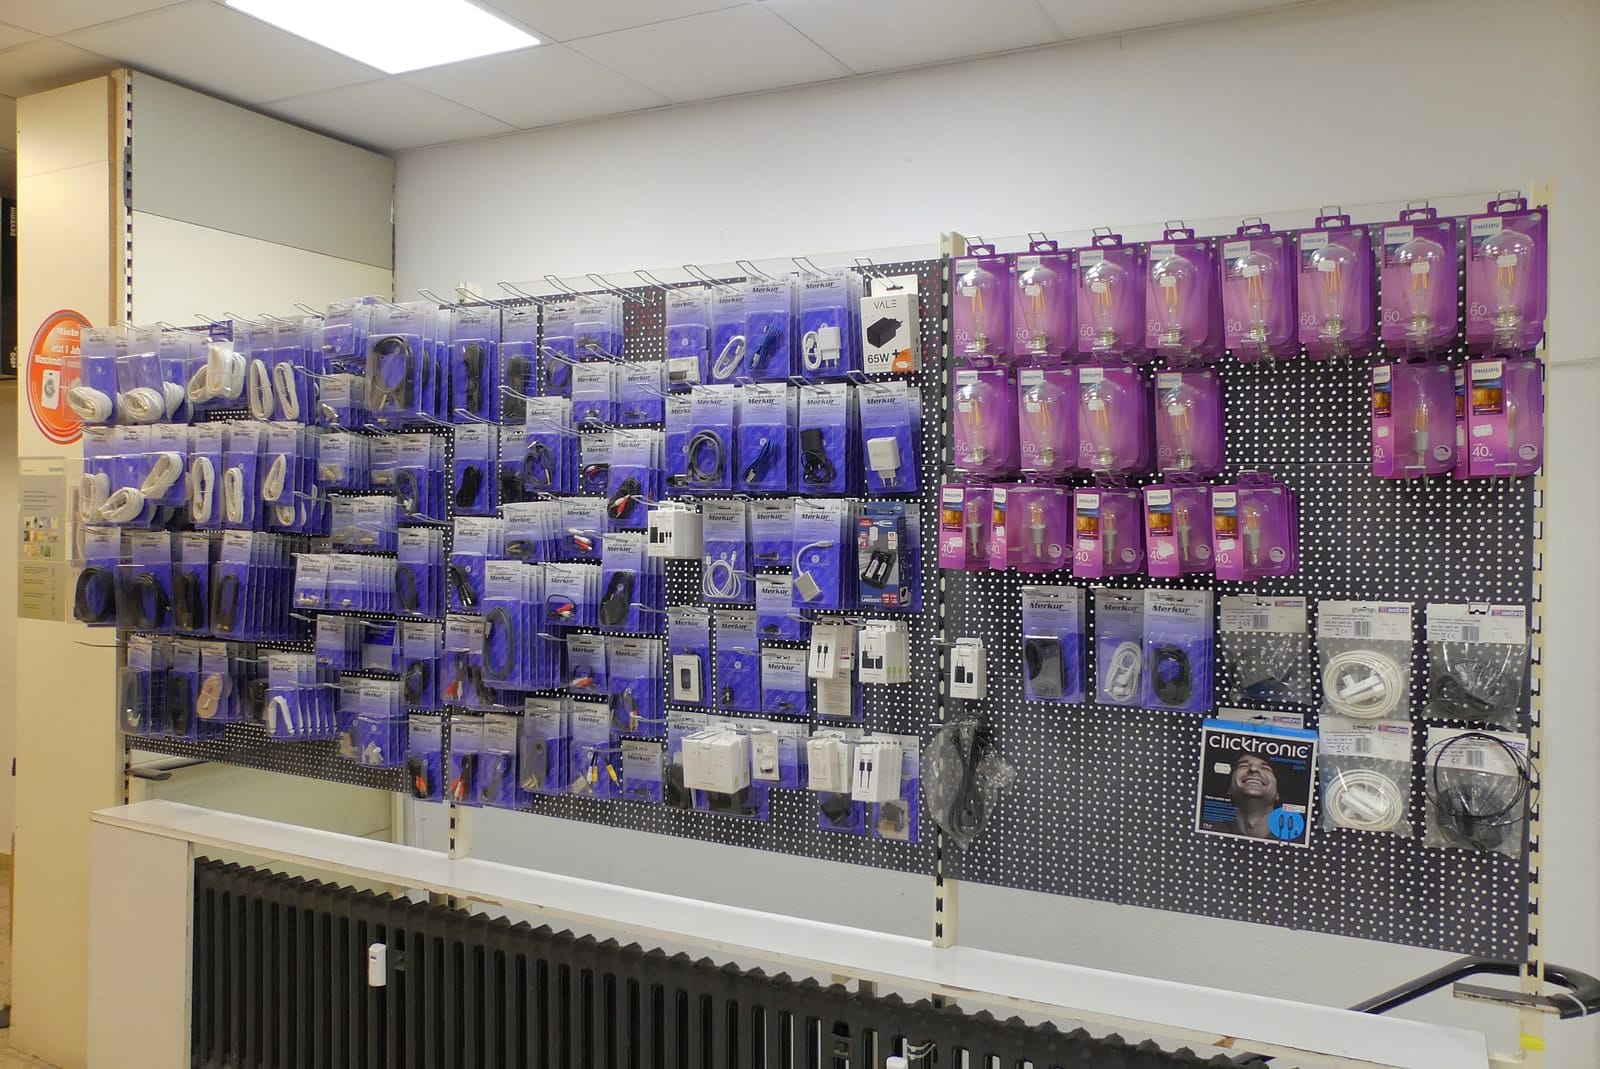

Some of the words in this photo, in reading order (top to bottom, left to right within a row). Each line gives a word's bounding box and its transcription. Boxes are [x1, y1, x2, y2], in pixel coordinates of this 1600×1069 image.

[718, 296, 744, 304] Merkur
[874, 300, 897, 309] VALE
[868, 353, 889, 364] 65W
[1209, 734, 1308, 758] clicktronic
